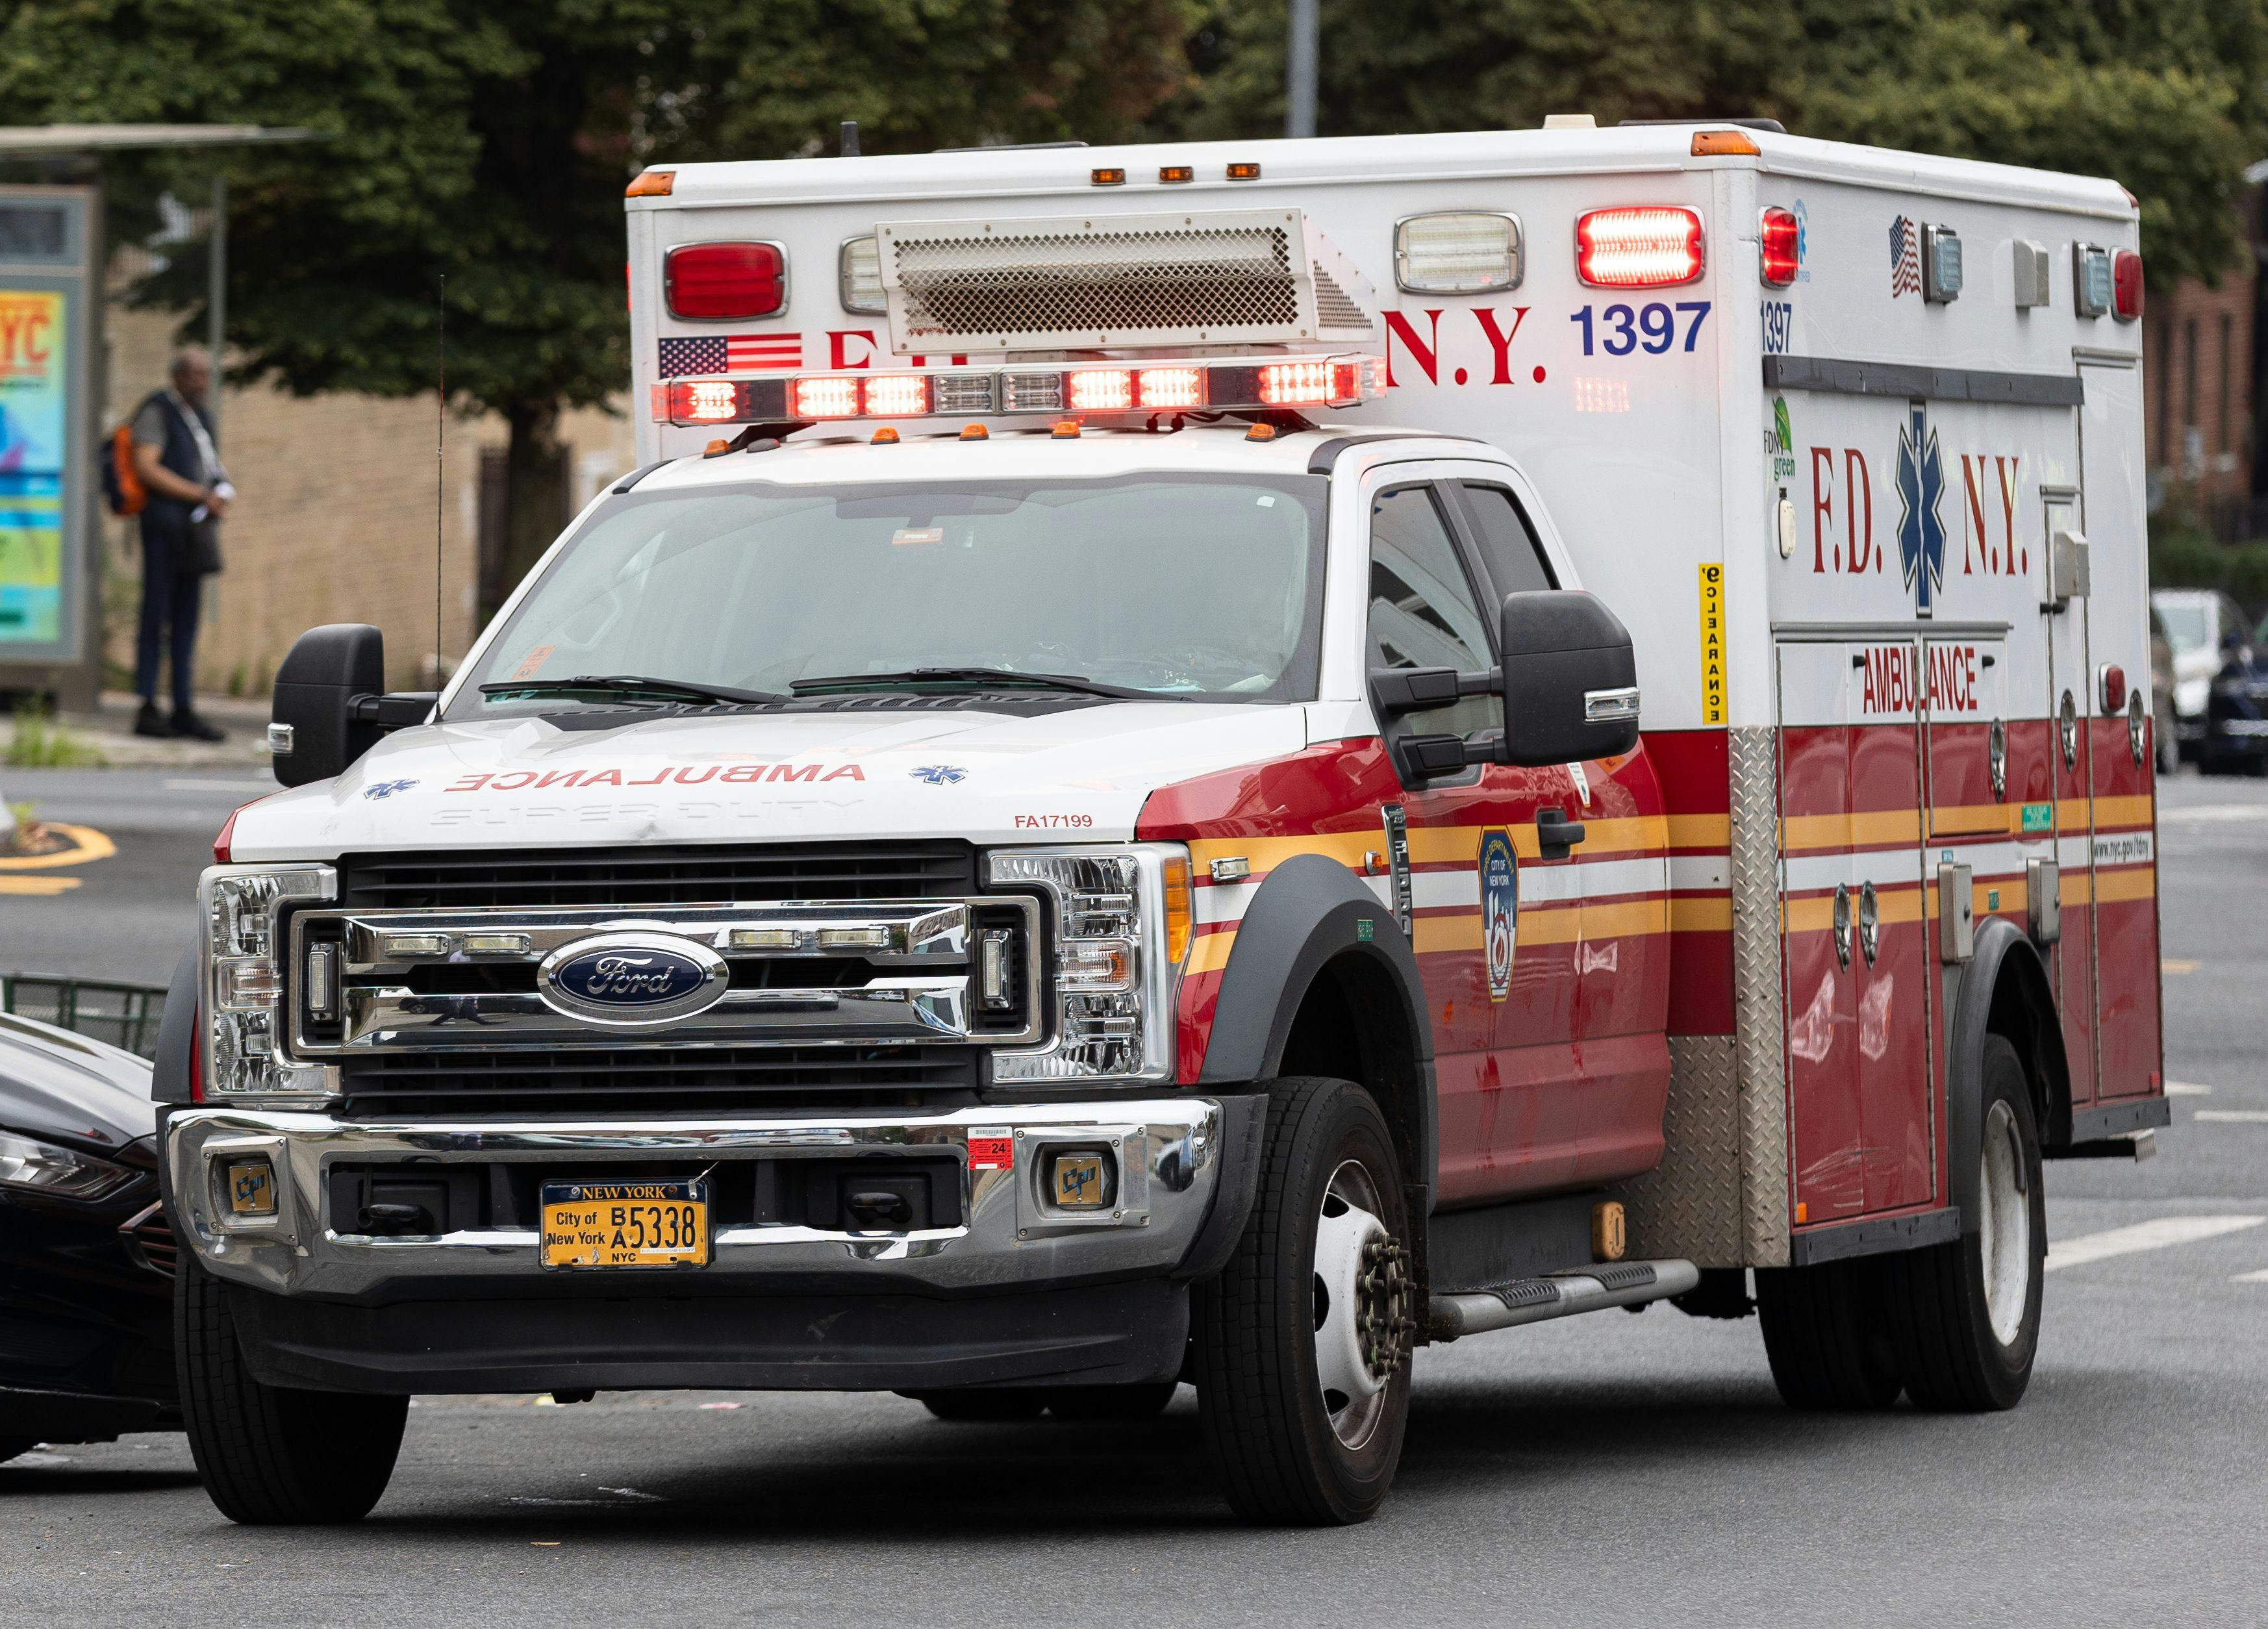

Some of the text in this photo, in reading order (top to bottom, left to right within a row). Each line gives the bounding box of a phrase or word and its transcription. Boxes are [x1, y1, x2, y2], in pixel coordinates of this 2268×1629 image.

[1570, 301, 1711, 355] 1397
[1760, 299, 1791, 353] 1397
[1381, 307, 1546, 387] N.Y.
[1763, 429, 1784, 455] FDNY
[1774, 457, 1796, 482] green
[1810, 446, 2028, 576] F.D. N.Y.
[1863, 645, 1978, 714] AMBUANCE
[678, 799, 865, 820] DUTY
[1014, 814, 1092, 828] FA17199
[587, 956, 675, 994] Ford
[991, 1143, 1006, 1154] 24
[582, 1186, 666, 1200] NEW YORK
[556, 1211, 598, 1228] City of
[548, 1231, 606, 1246] New York
[611, 1253, 636, 1263] NYC
